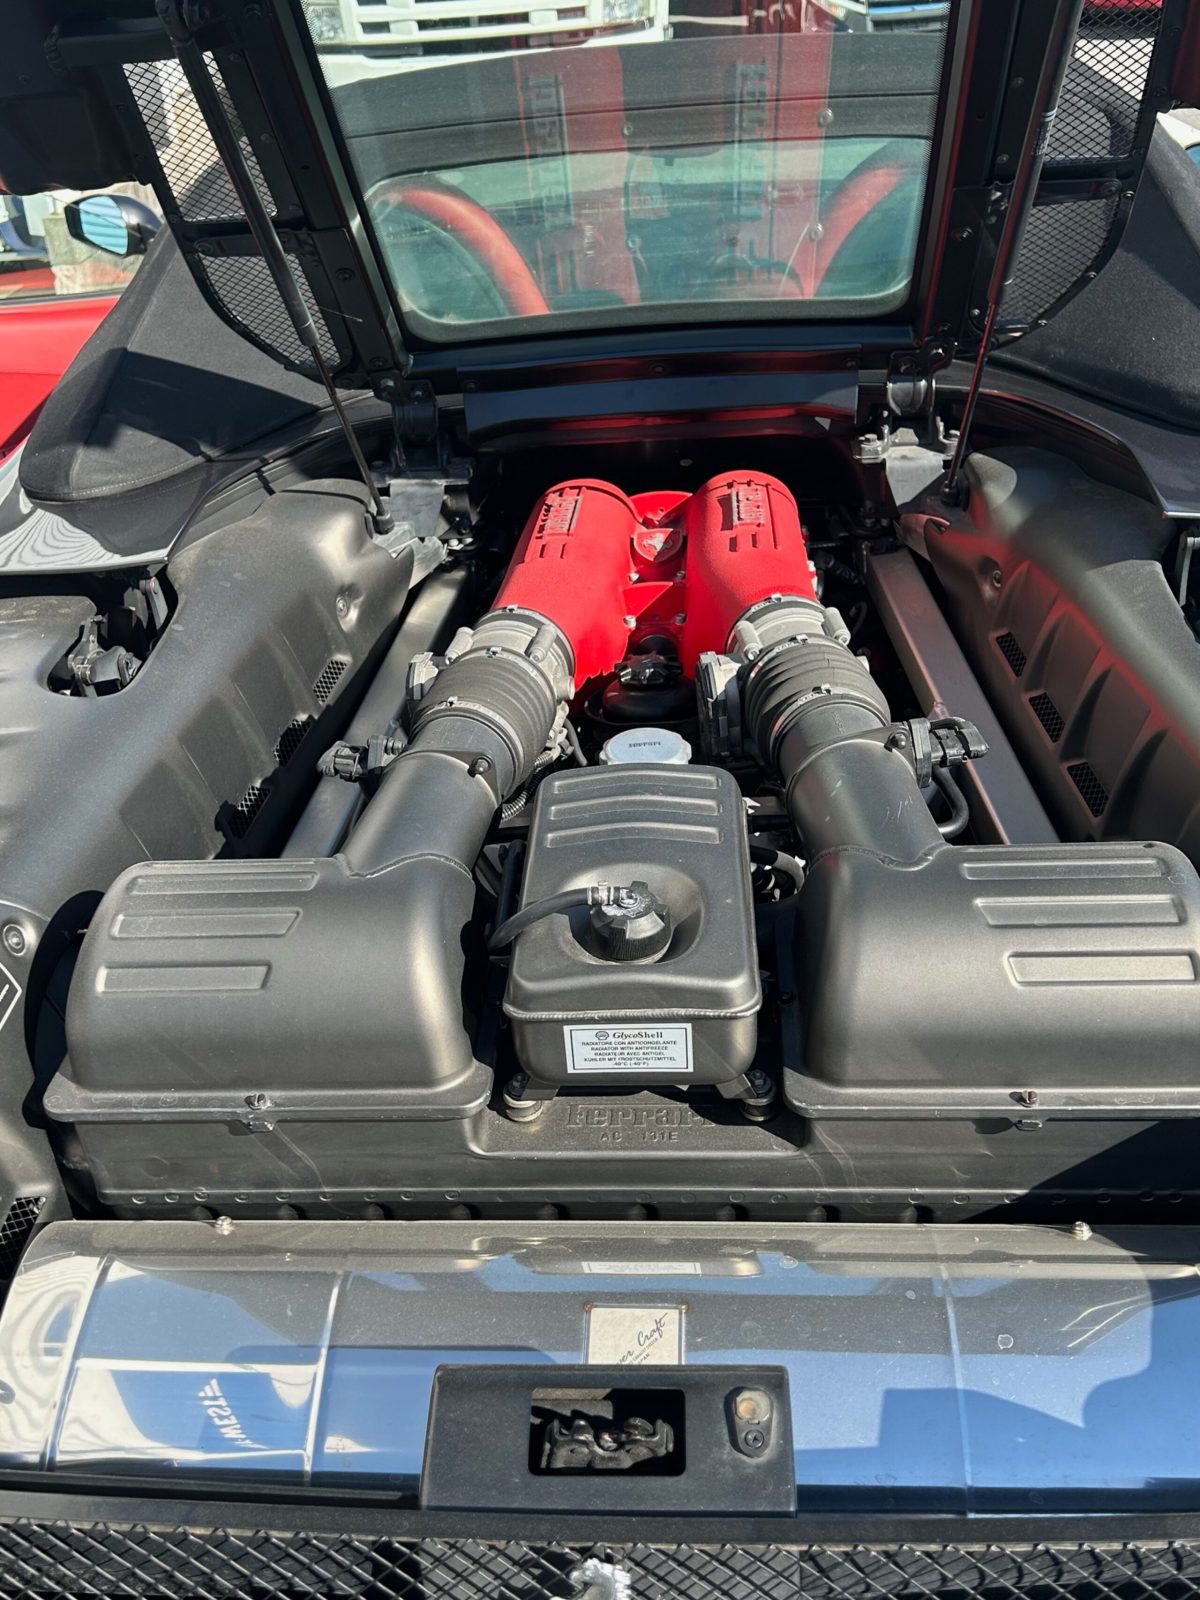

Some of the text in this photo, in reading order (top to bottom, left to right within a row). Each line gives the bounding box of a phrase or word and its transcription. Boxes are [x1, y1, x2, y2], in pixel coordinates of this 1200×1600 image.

[612, 1031, 663, 1040] GlycoShell
[600, 1131, 623, 1142] AC
[637, 1312, 668, 1347] Craft
